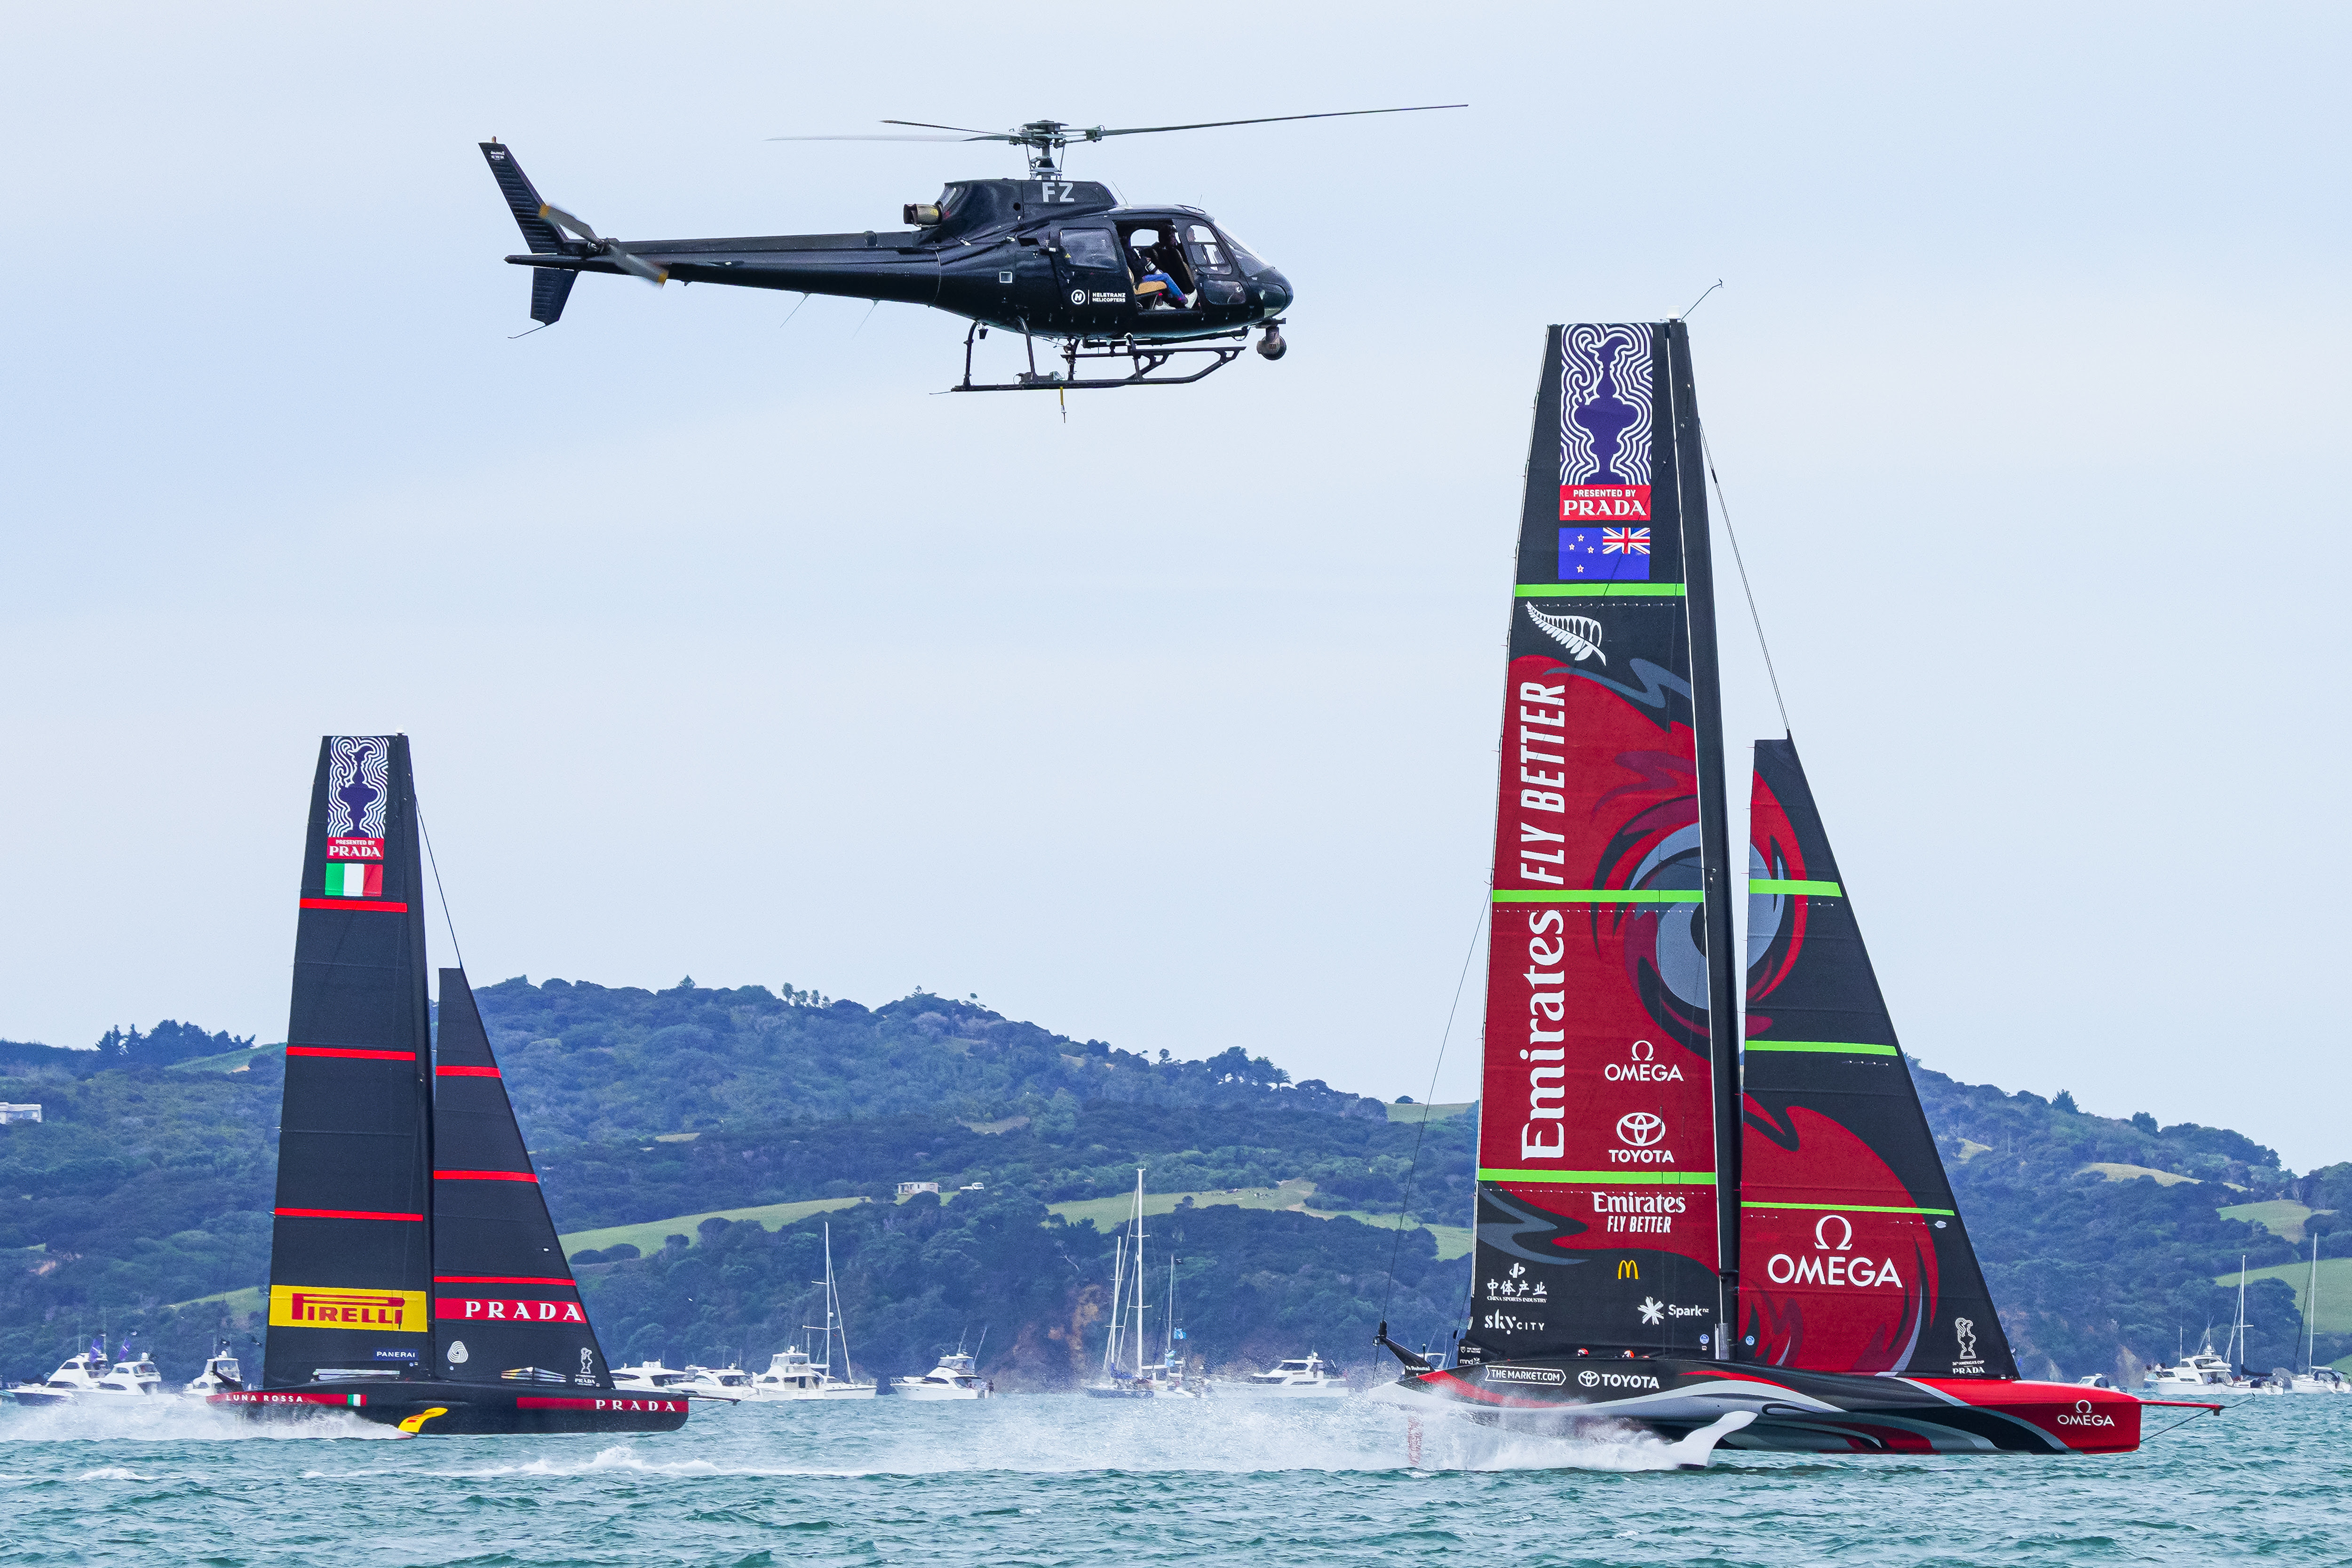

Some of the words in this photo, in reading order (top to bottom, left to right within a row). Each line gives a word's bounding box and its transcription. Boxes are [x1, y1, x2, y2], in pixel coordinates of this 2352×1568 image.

[1042, 182, 1074, 202] FZ
[1573, 489, 1623, 498] PRESENTED
[1563, 500, 1647, 516] PRADA
[1520, 682, 1565, 814] BETTER
[329, 846, 381, 857] PRADA
[1520, 822, 1565, 885] FLY
[1519, 909, 1565, 1161] Emirates
[1604, 1064, 1684, 1082] OMEGA
[1608, 1150, 1675, 1163] TOYOTA
[1592, 1192, 1686, 1213] Emirates
[1607, 1216, 1627, 1233] FLY
[1629, 1216, 1672, 1234] BETTER
[1767, 1253, 1903, 1288] OMEGA
[1487, 1279, 1547, 1297] 中体产业
[292, 1293, 405, 1324] PIRELLI
[465, 1301, 582, 1321] PRADA
[1602, 1374, 1660, 1389] TOYOTA
[595, 1400, 676, 1412] PRADA
[2058, 1415, 2115, 1427] OMEGA
